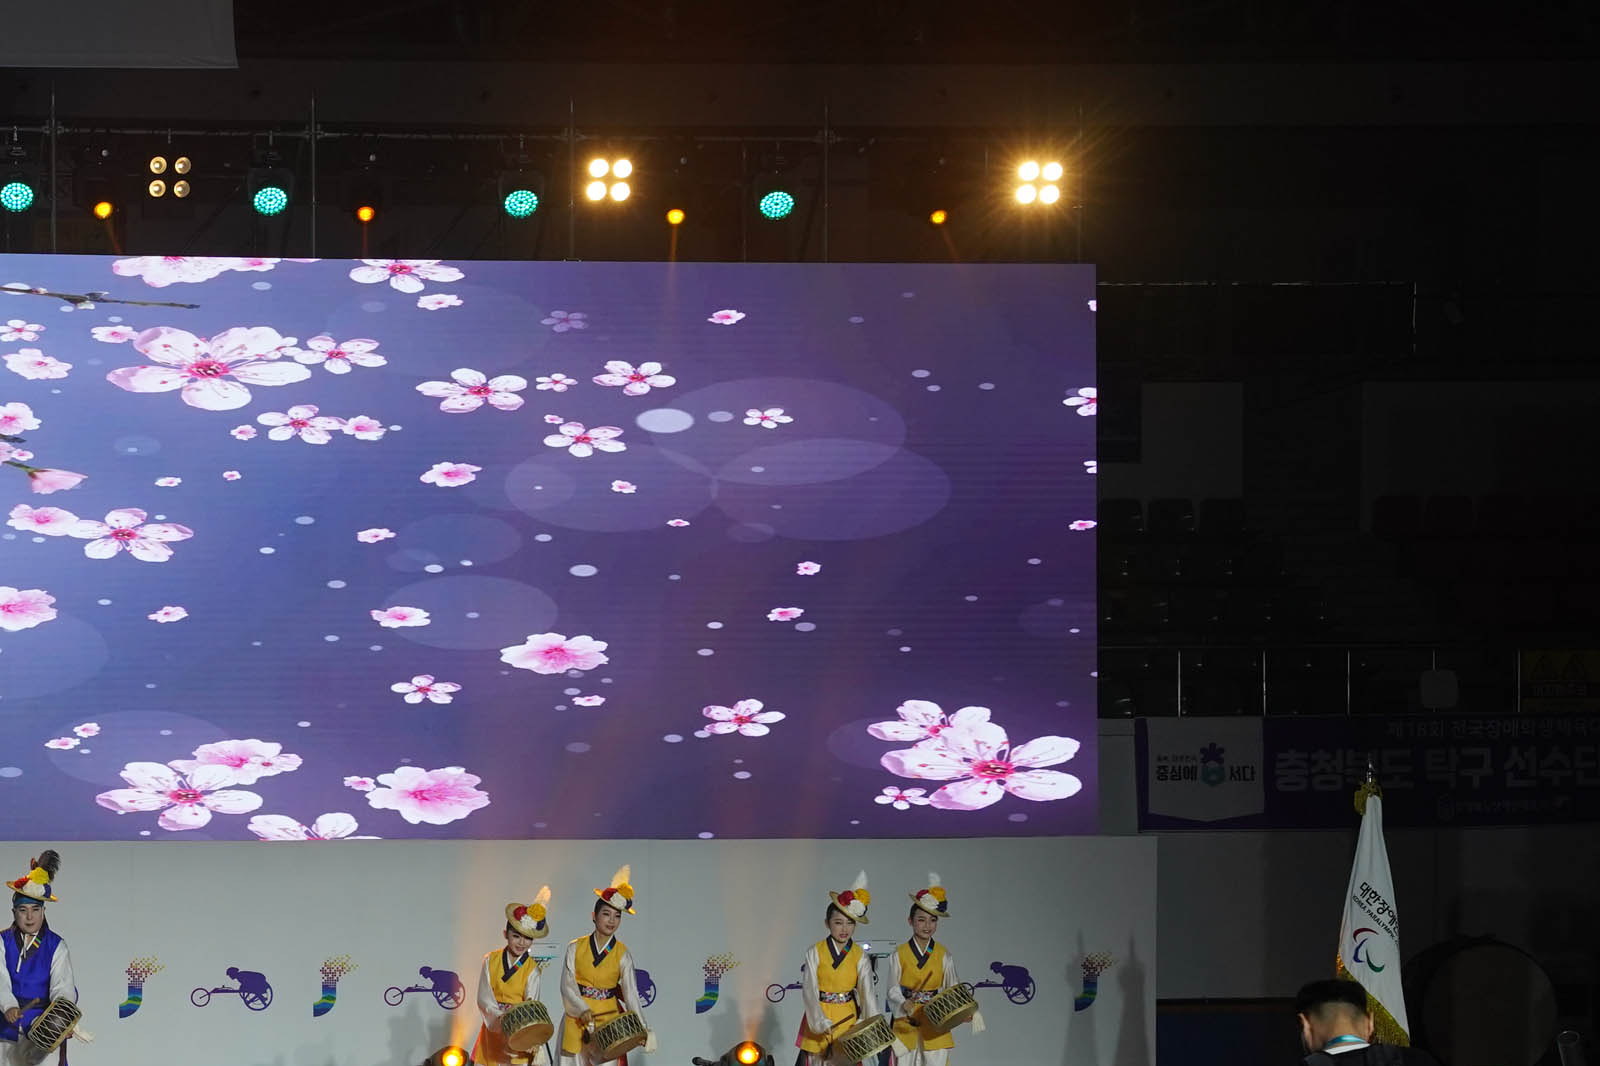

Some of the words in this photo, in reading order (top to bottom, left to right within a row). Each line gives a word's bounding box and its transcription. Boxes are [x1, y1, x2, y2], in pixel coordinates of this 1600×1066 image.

[1156, 765, 1198, 782] 중심에
[1229, 765, 1256, 782] 서다
[1425, 746, 1494, 789] 탁구
